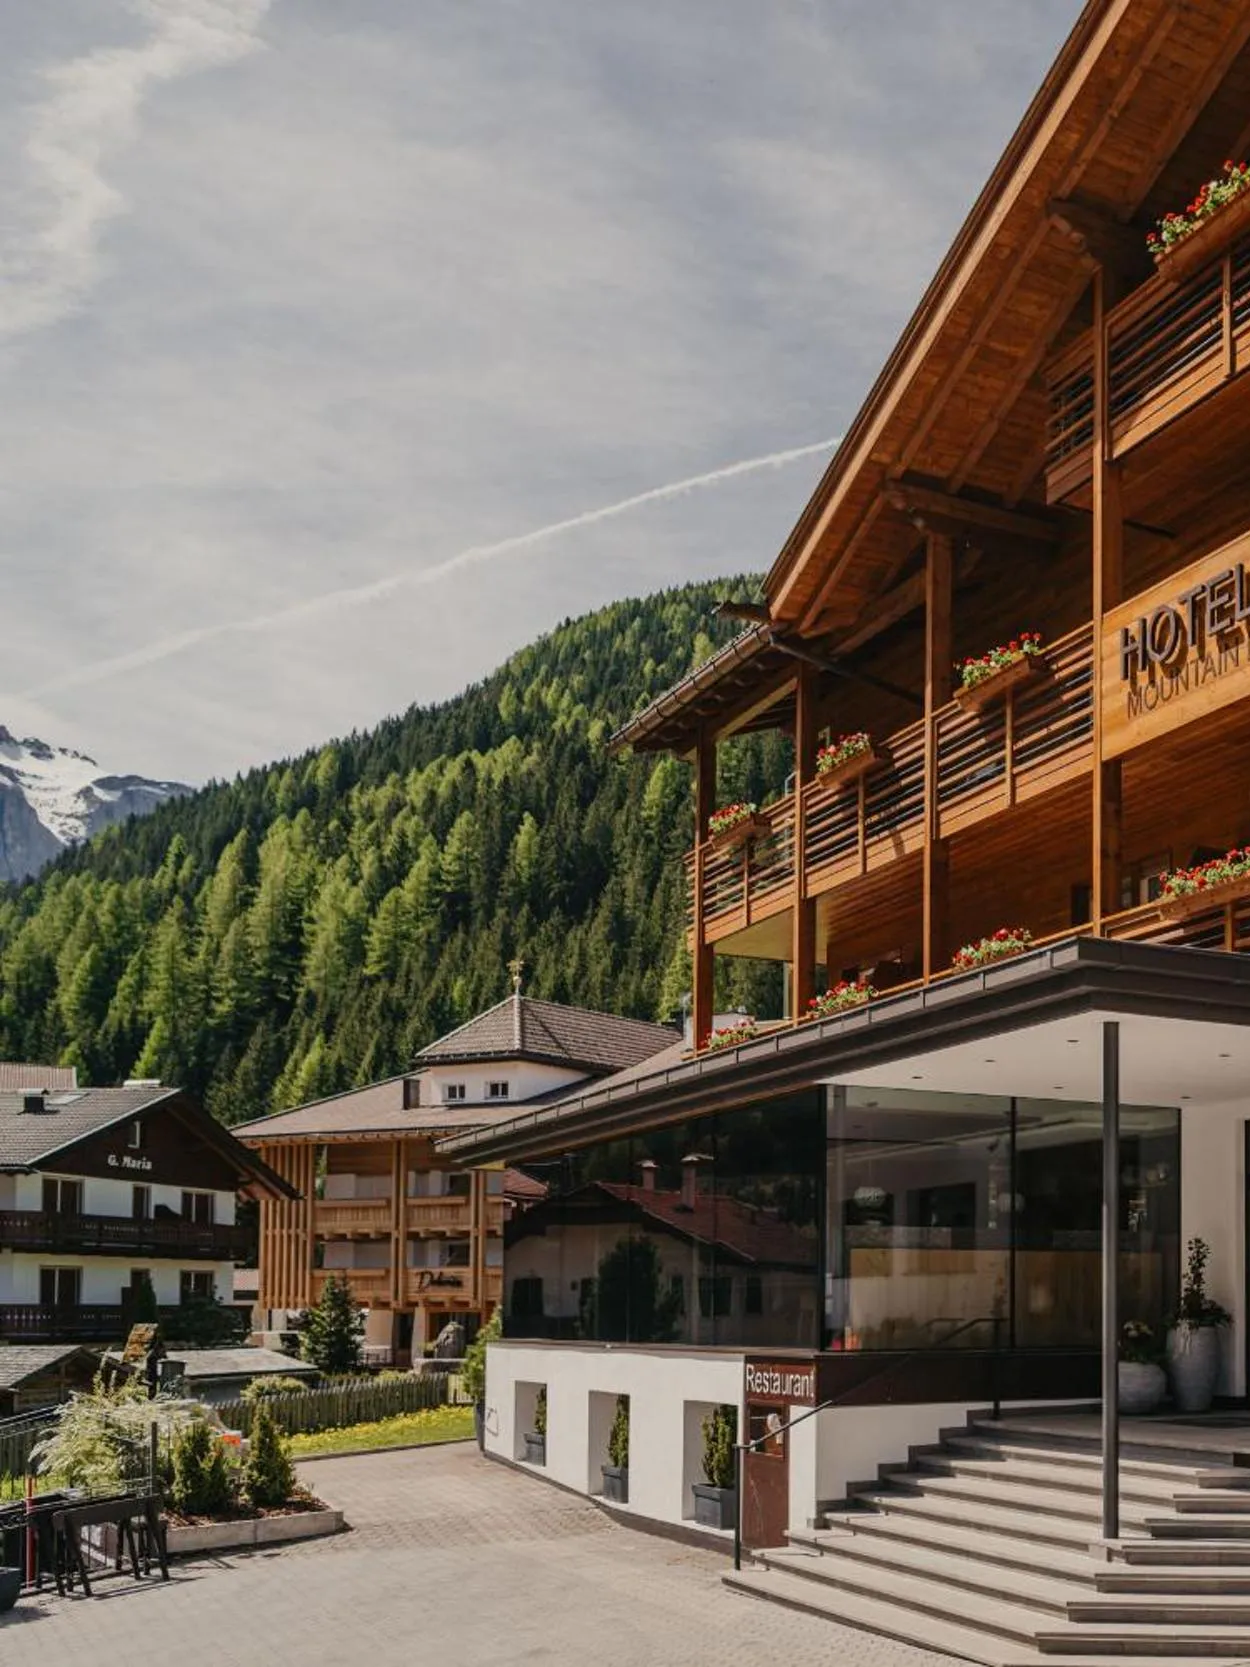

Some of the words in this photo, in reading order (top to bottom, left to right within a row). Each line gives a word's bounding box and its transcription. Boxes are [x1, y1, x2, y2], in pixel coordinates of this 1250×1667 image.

[1127, 636, 1240, 719] MOUNTAIN
[122, 1155, 153, 1170] Maria
[746, 1363, 815, 1398] Restaurant
